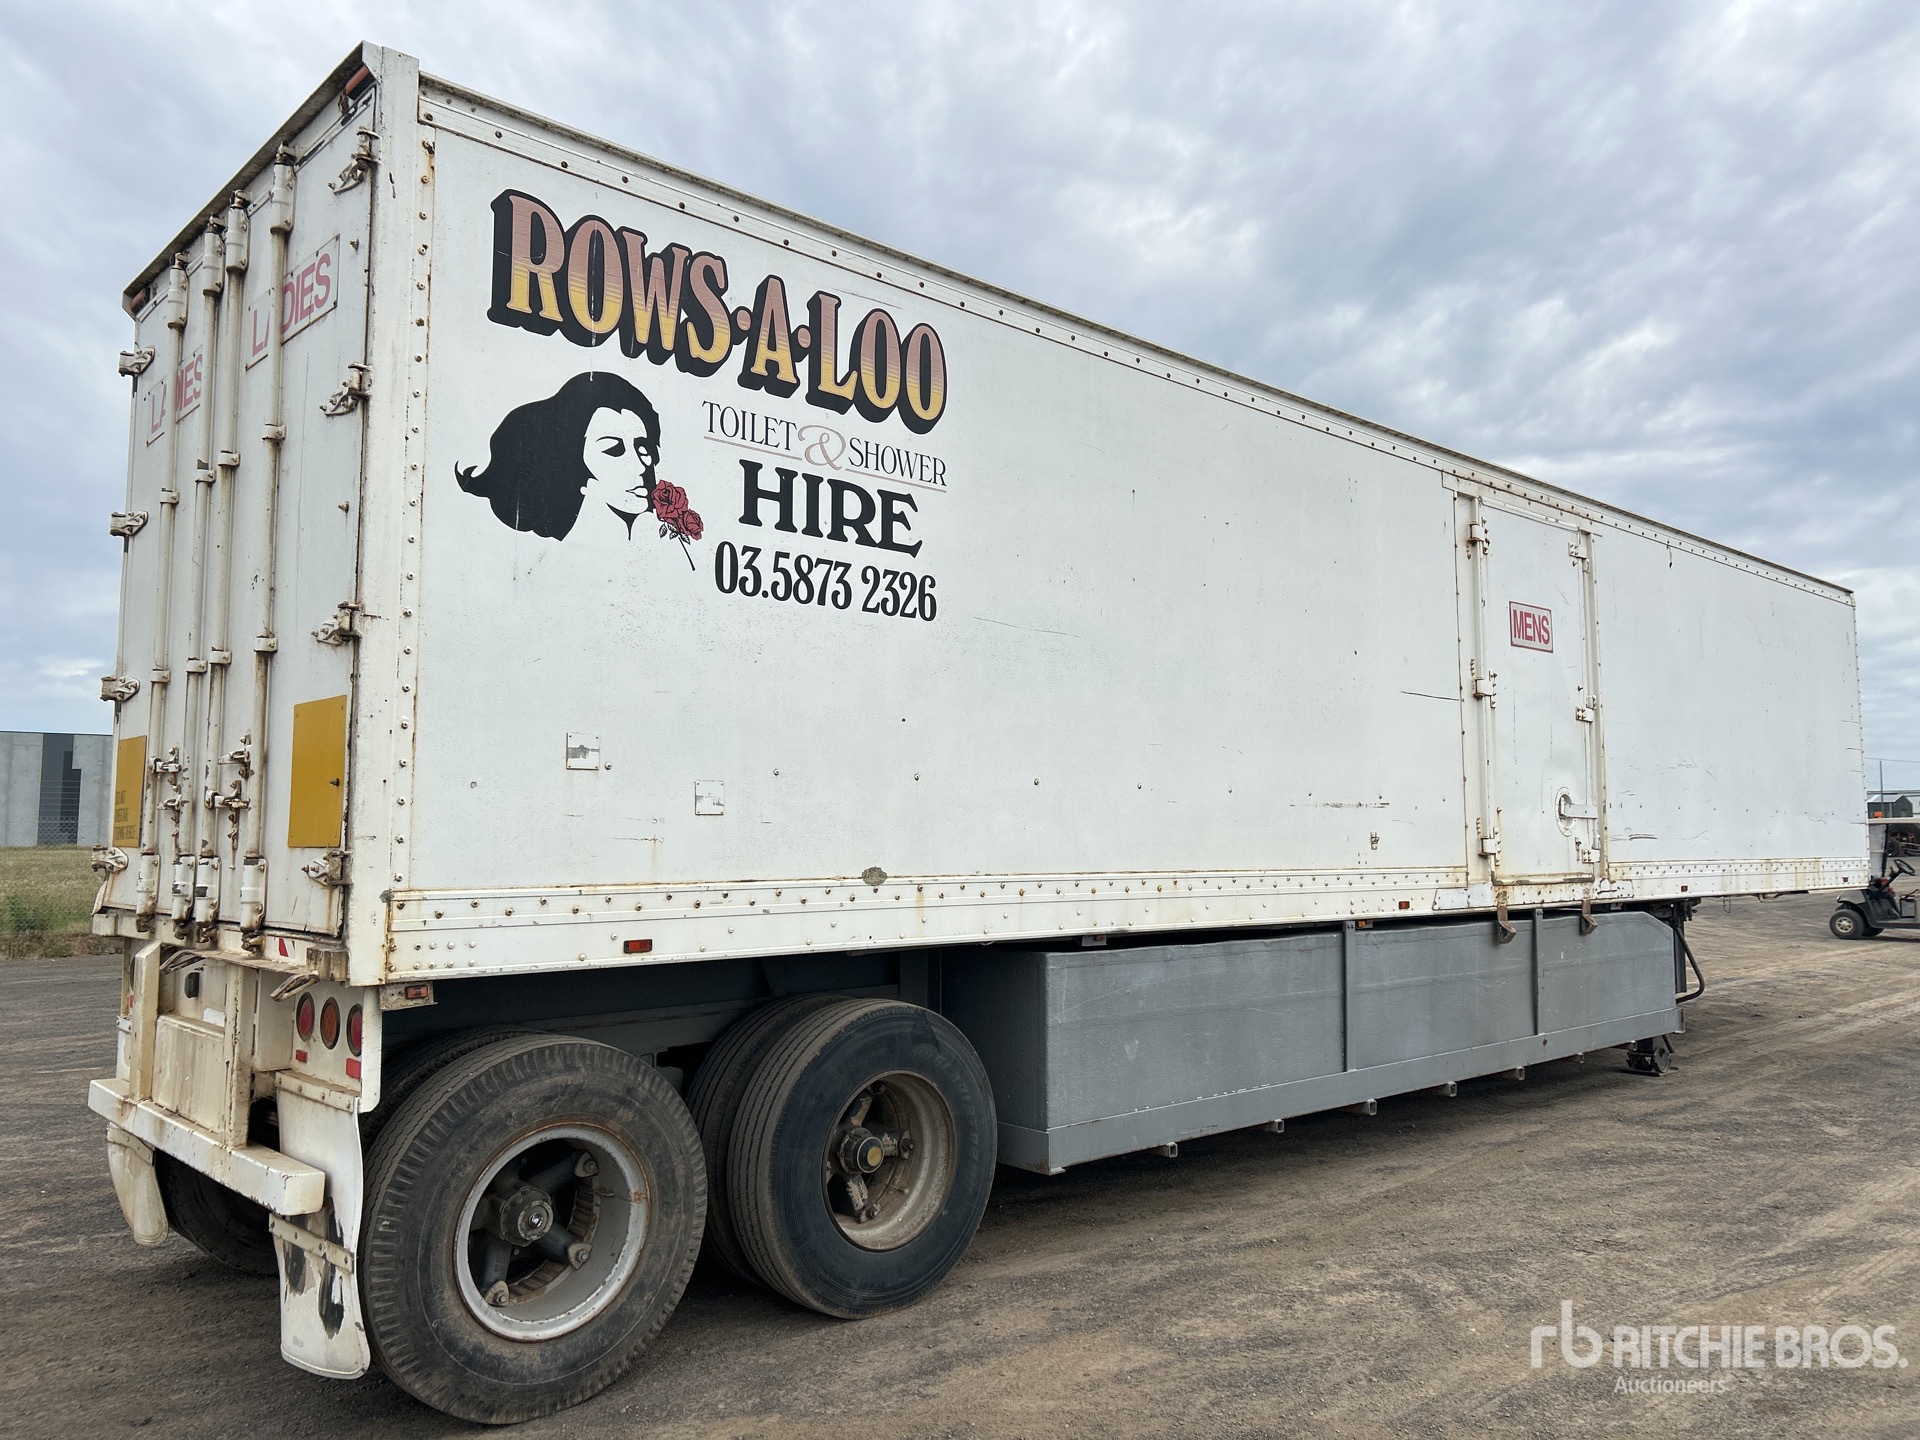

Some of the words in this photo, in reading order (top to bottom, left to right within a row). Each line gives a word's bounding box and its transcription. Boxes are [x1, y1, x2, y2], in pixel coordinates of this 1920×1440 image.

[702, 400, 797, 451] TOILET
[797, 425, 846, 470] &
[848, 437, 947, 487] SHOWER
[738, 459, 923, 559] HIRE
[714, 541, 852, 610] 03.5873
[861, 565, 938, 622] 2326
[1513, 609, 1550, 645] MENS
